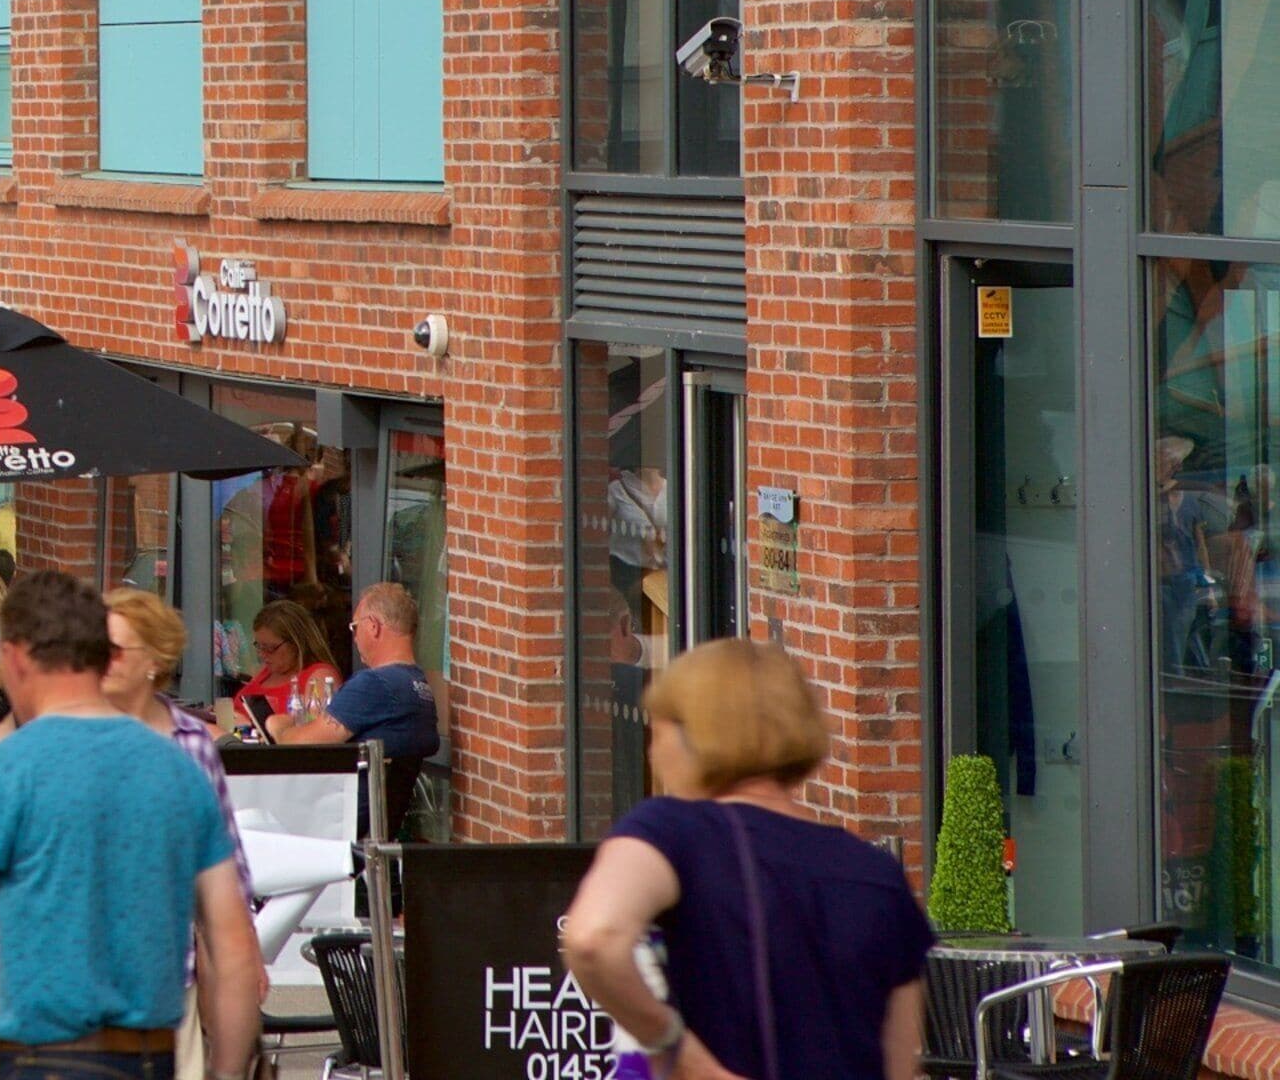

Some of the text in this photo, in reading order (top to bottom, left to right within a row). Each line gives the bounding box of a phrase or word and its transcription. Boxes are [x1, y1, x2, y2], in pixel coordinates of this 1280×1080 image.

[193, 276, 278, 343] Corretto
[984, 312, 1007, 320] CCTV
[486, 967, 603, 1010] HEA
